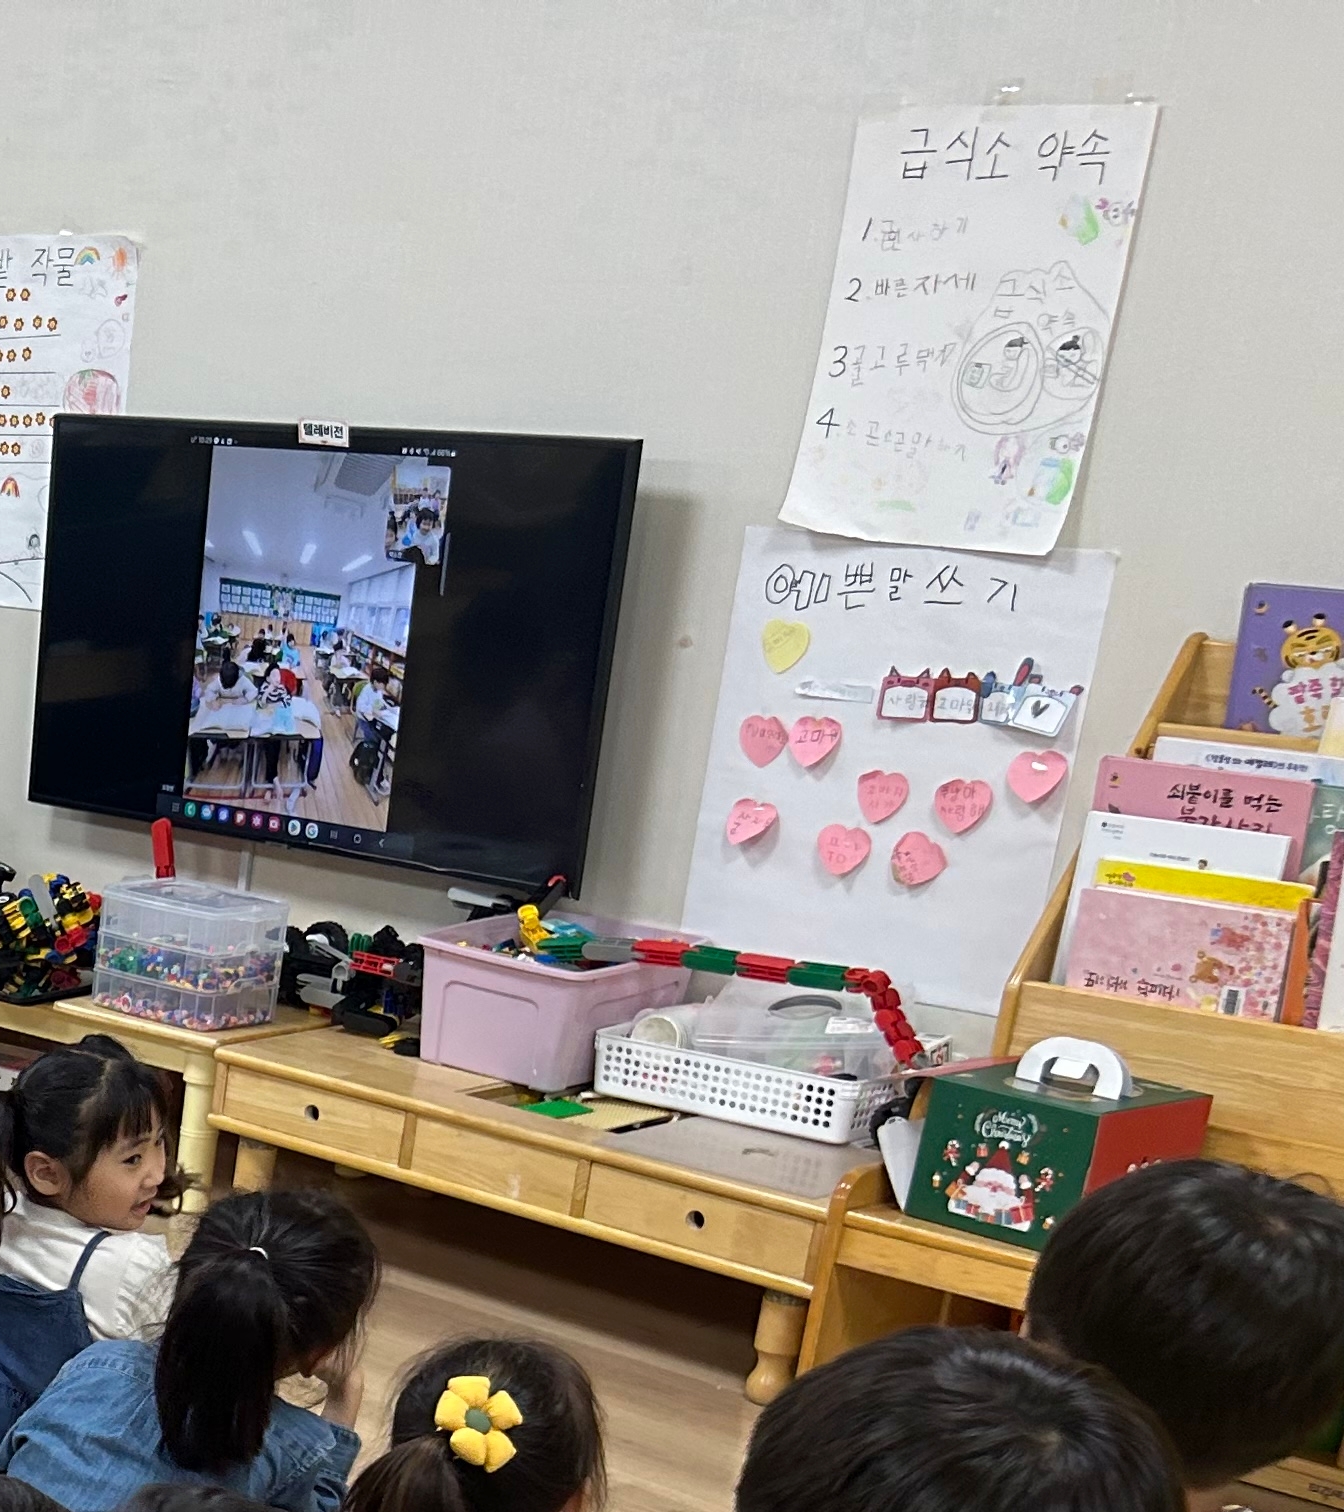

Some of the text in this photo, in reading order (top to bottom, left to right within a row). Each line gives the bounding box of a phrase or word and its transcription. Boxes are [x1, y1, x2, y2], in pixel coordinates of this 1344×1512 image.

[900, 126, 1111, 186] 급식소 약속
[30, 245, 76, 288] 작물
[303, 423, 344, 440] 텔레비전
[1167, 783, 1284, 813] 쇠붙이를 먹는
